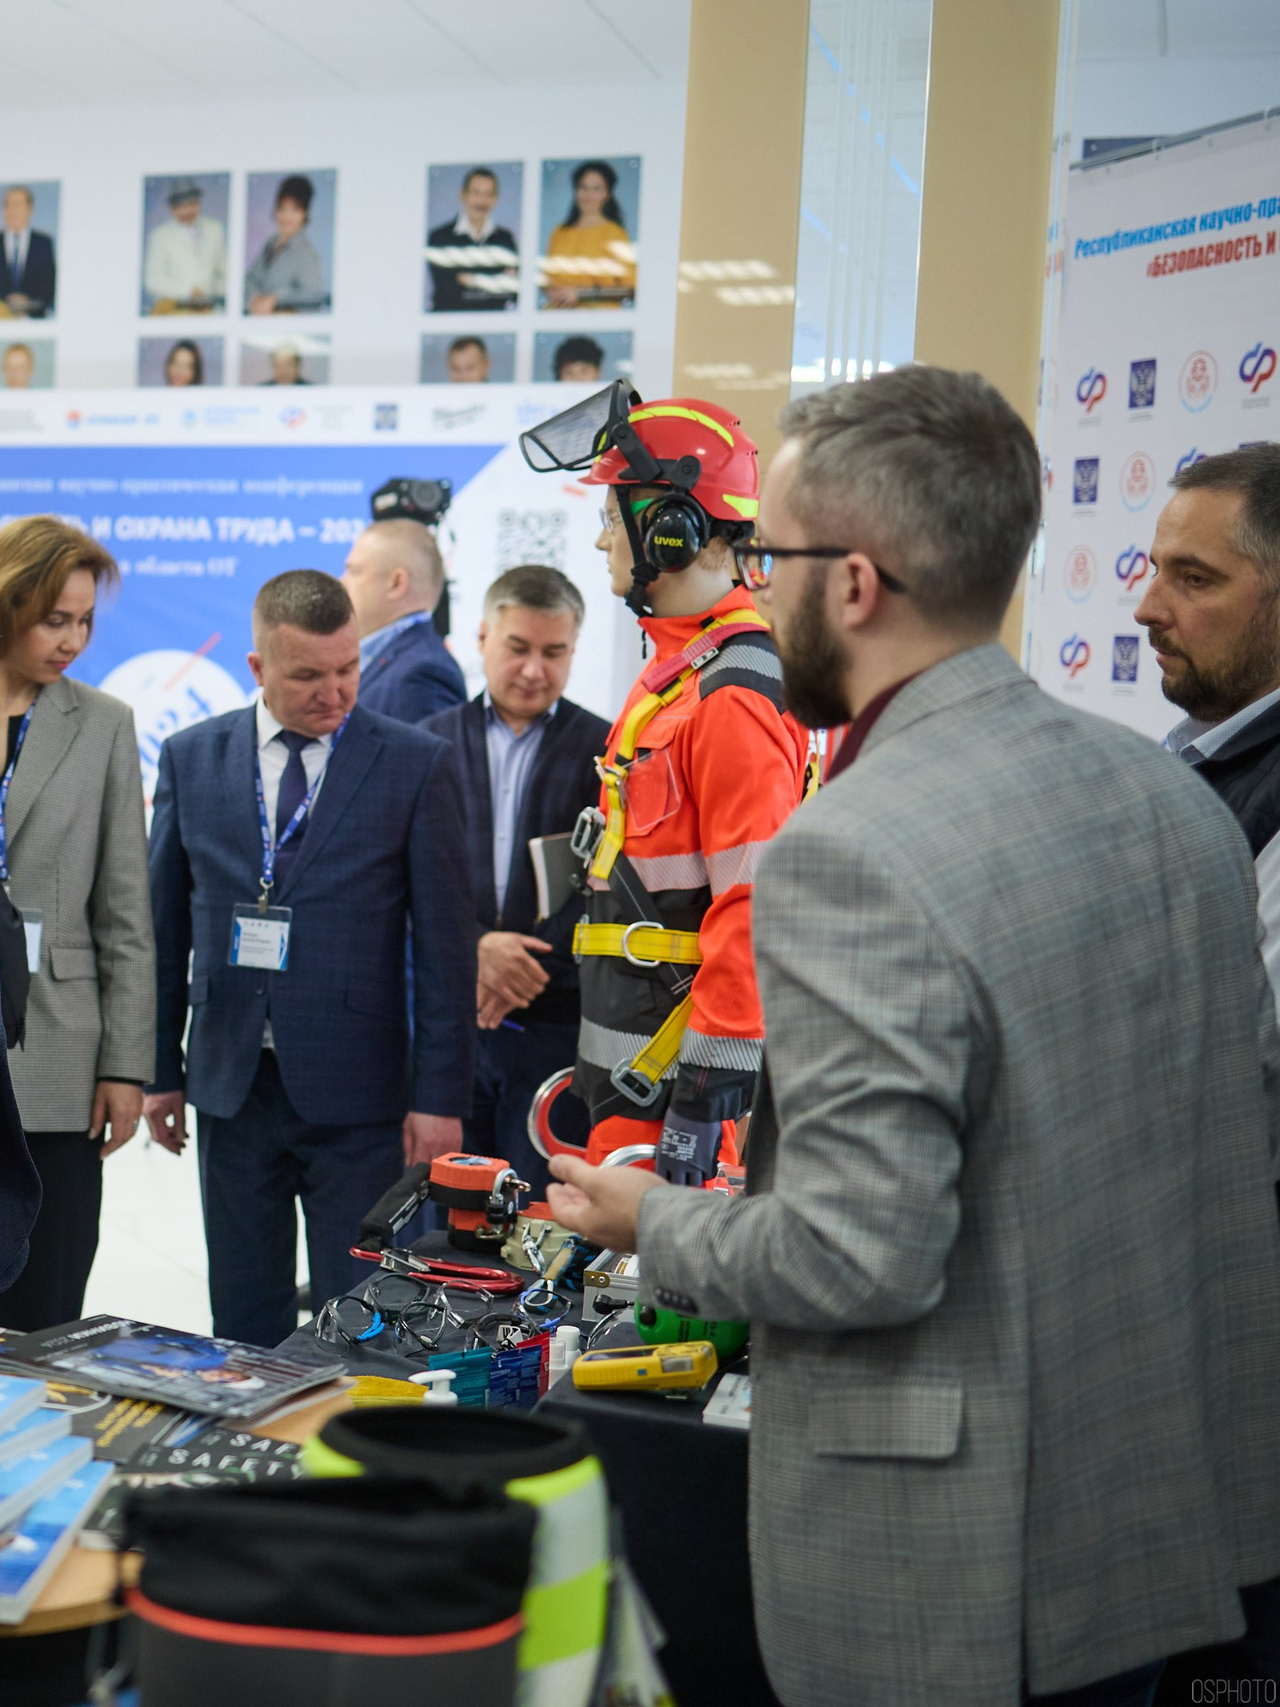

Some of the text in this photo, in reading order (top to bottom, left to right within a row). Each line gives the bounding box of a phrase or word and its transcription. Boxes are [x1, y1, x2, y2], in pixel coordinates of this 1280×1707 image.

[1075, 214, 1198, 259] Республиканская
[1266, 230, 1277, 256] И
[114, 516, 212, 541] ОХРАНА
[215, 517, 296, 546] ТРУДА
[654, 535, 684, 548] uvex
